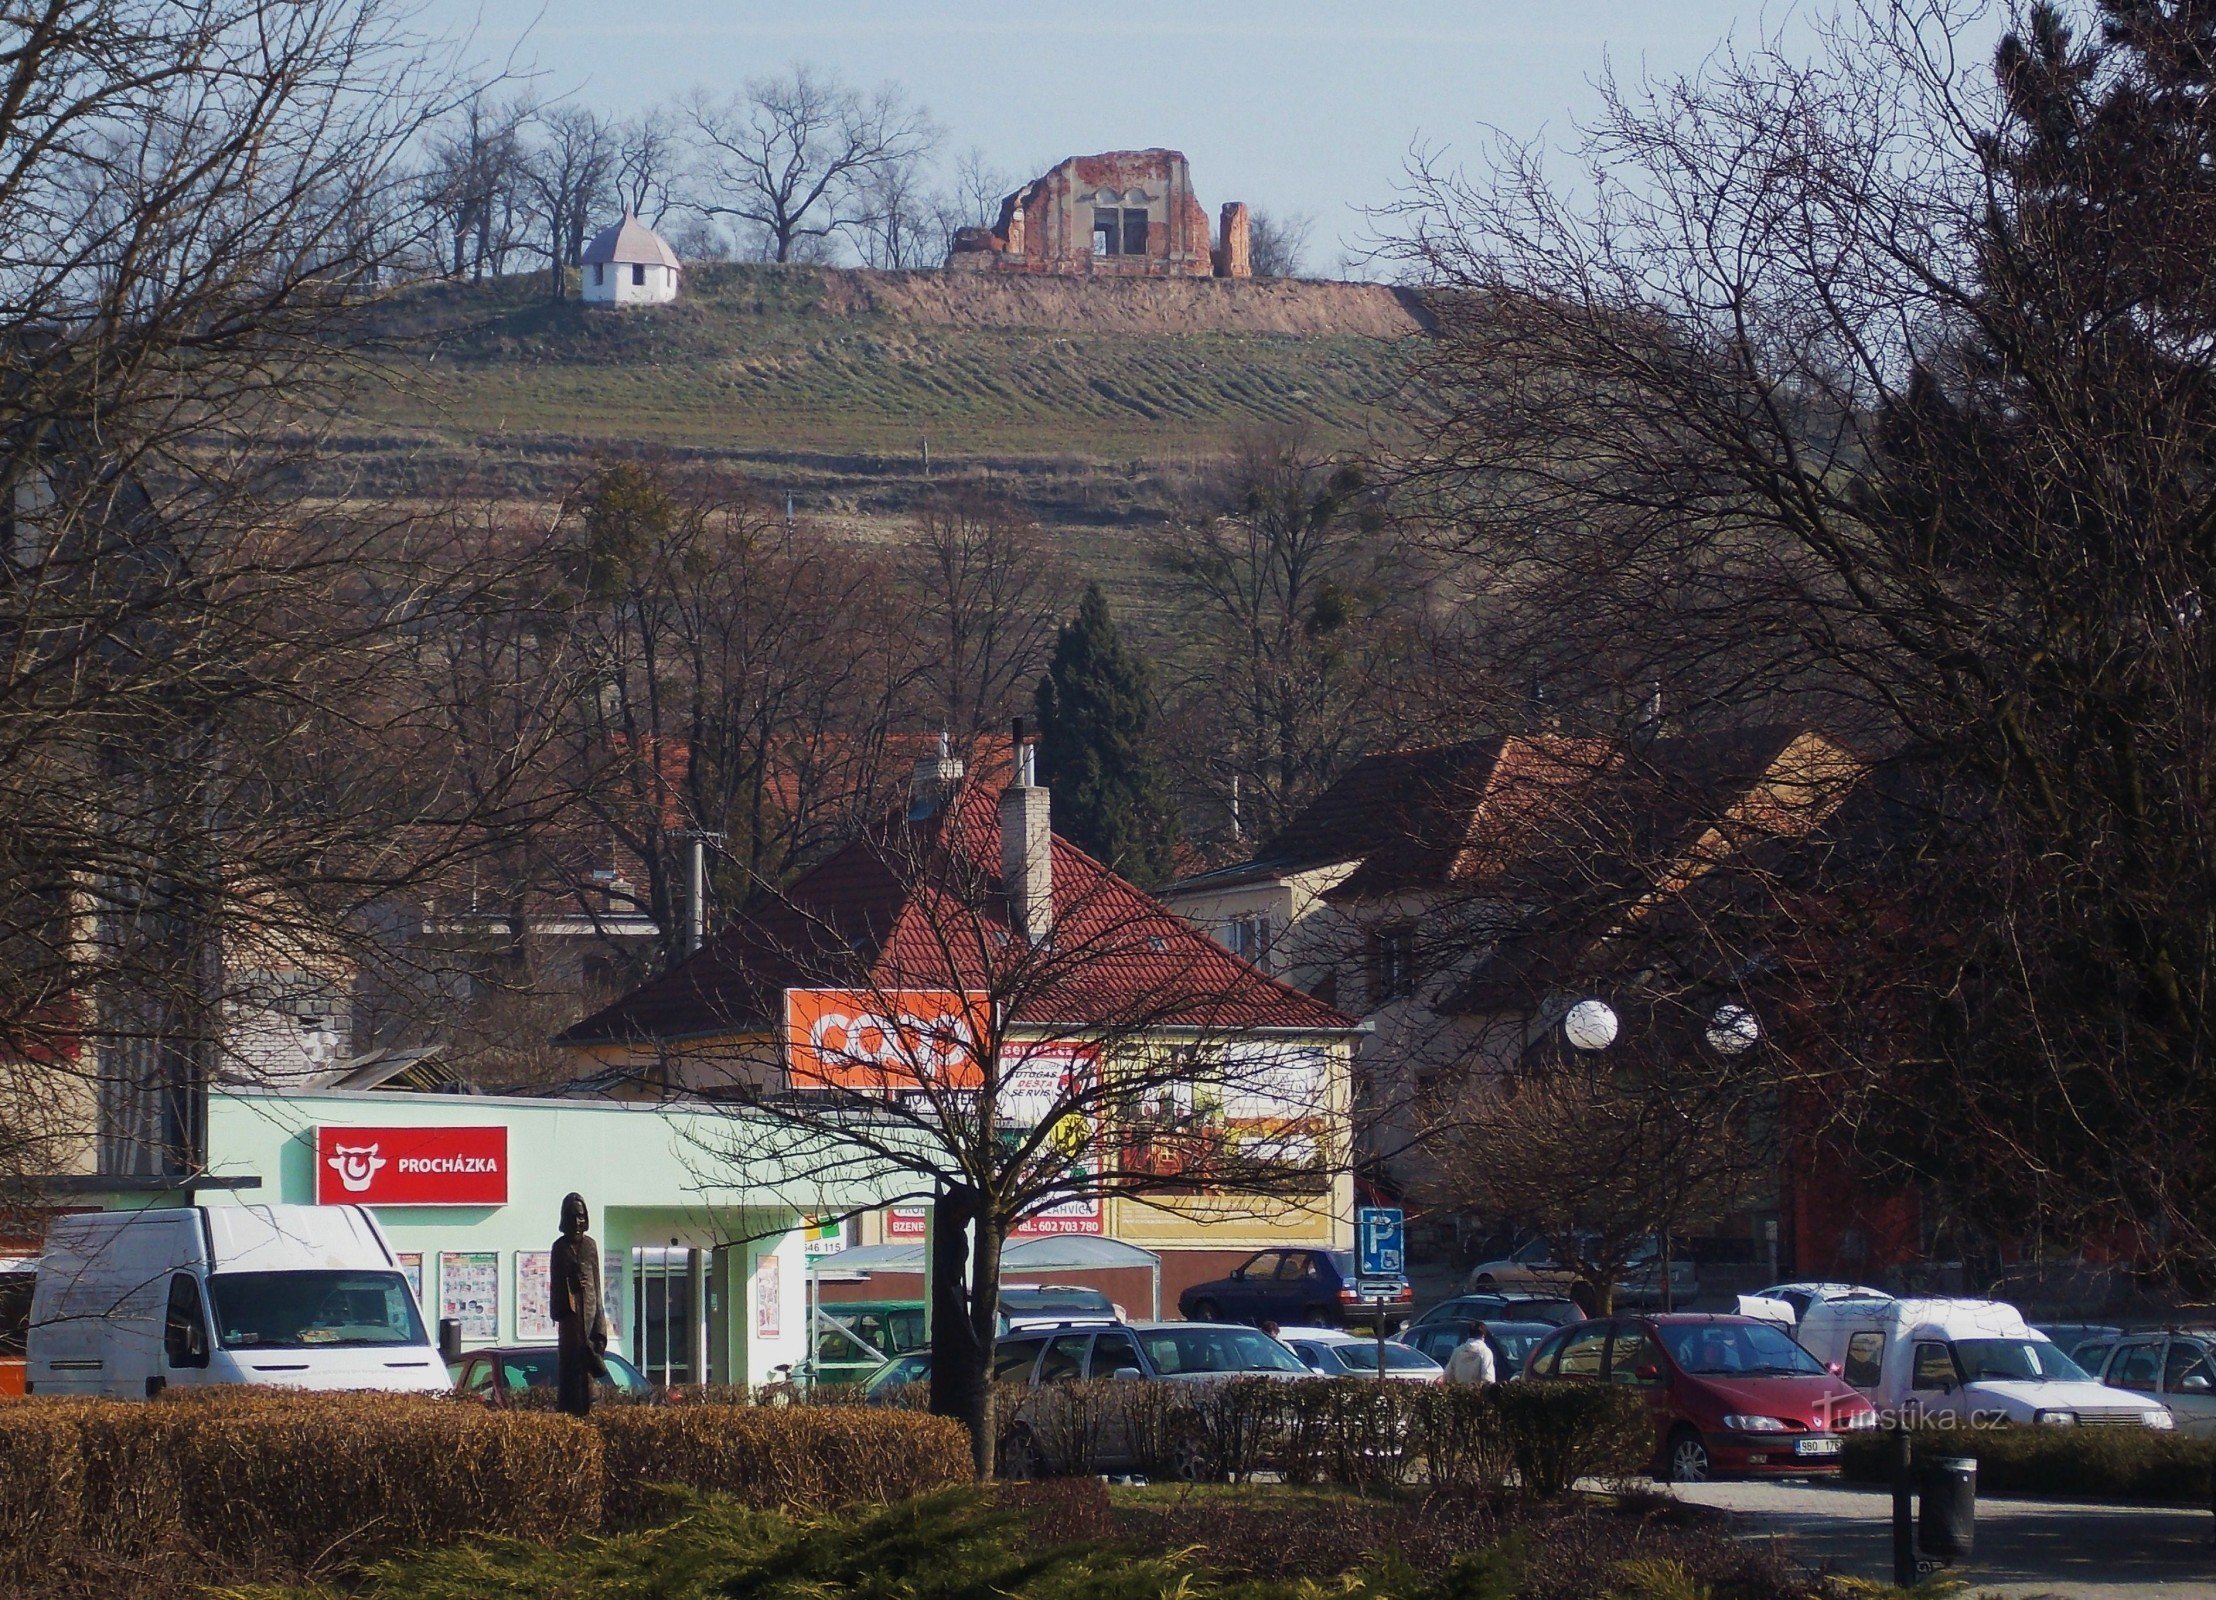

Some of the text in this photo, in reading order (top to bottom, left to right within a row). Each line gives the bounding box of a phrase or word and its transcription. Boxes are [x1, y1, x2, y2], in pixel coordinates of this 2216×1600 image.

[810, 1013, 972, 1077] coop
[1017, 1080, 1053, 1088] DESTA
[1011, 1089, 1051, 1097] SERVIS
[398, 1153, 497, 1173] PROCHÁZKA
[1038, 1221, 1058, 1232] 602
[1060, 1221, 1078, 1232] 703
[1080, 1221, 1099, 1232] 780
[1369, 1215, 1394, 1254] P
[824, 1243, 841, 1252] 115
